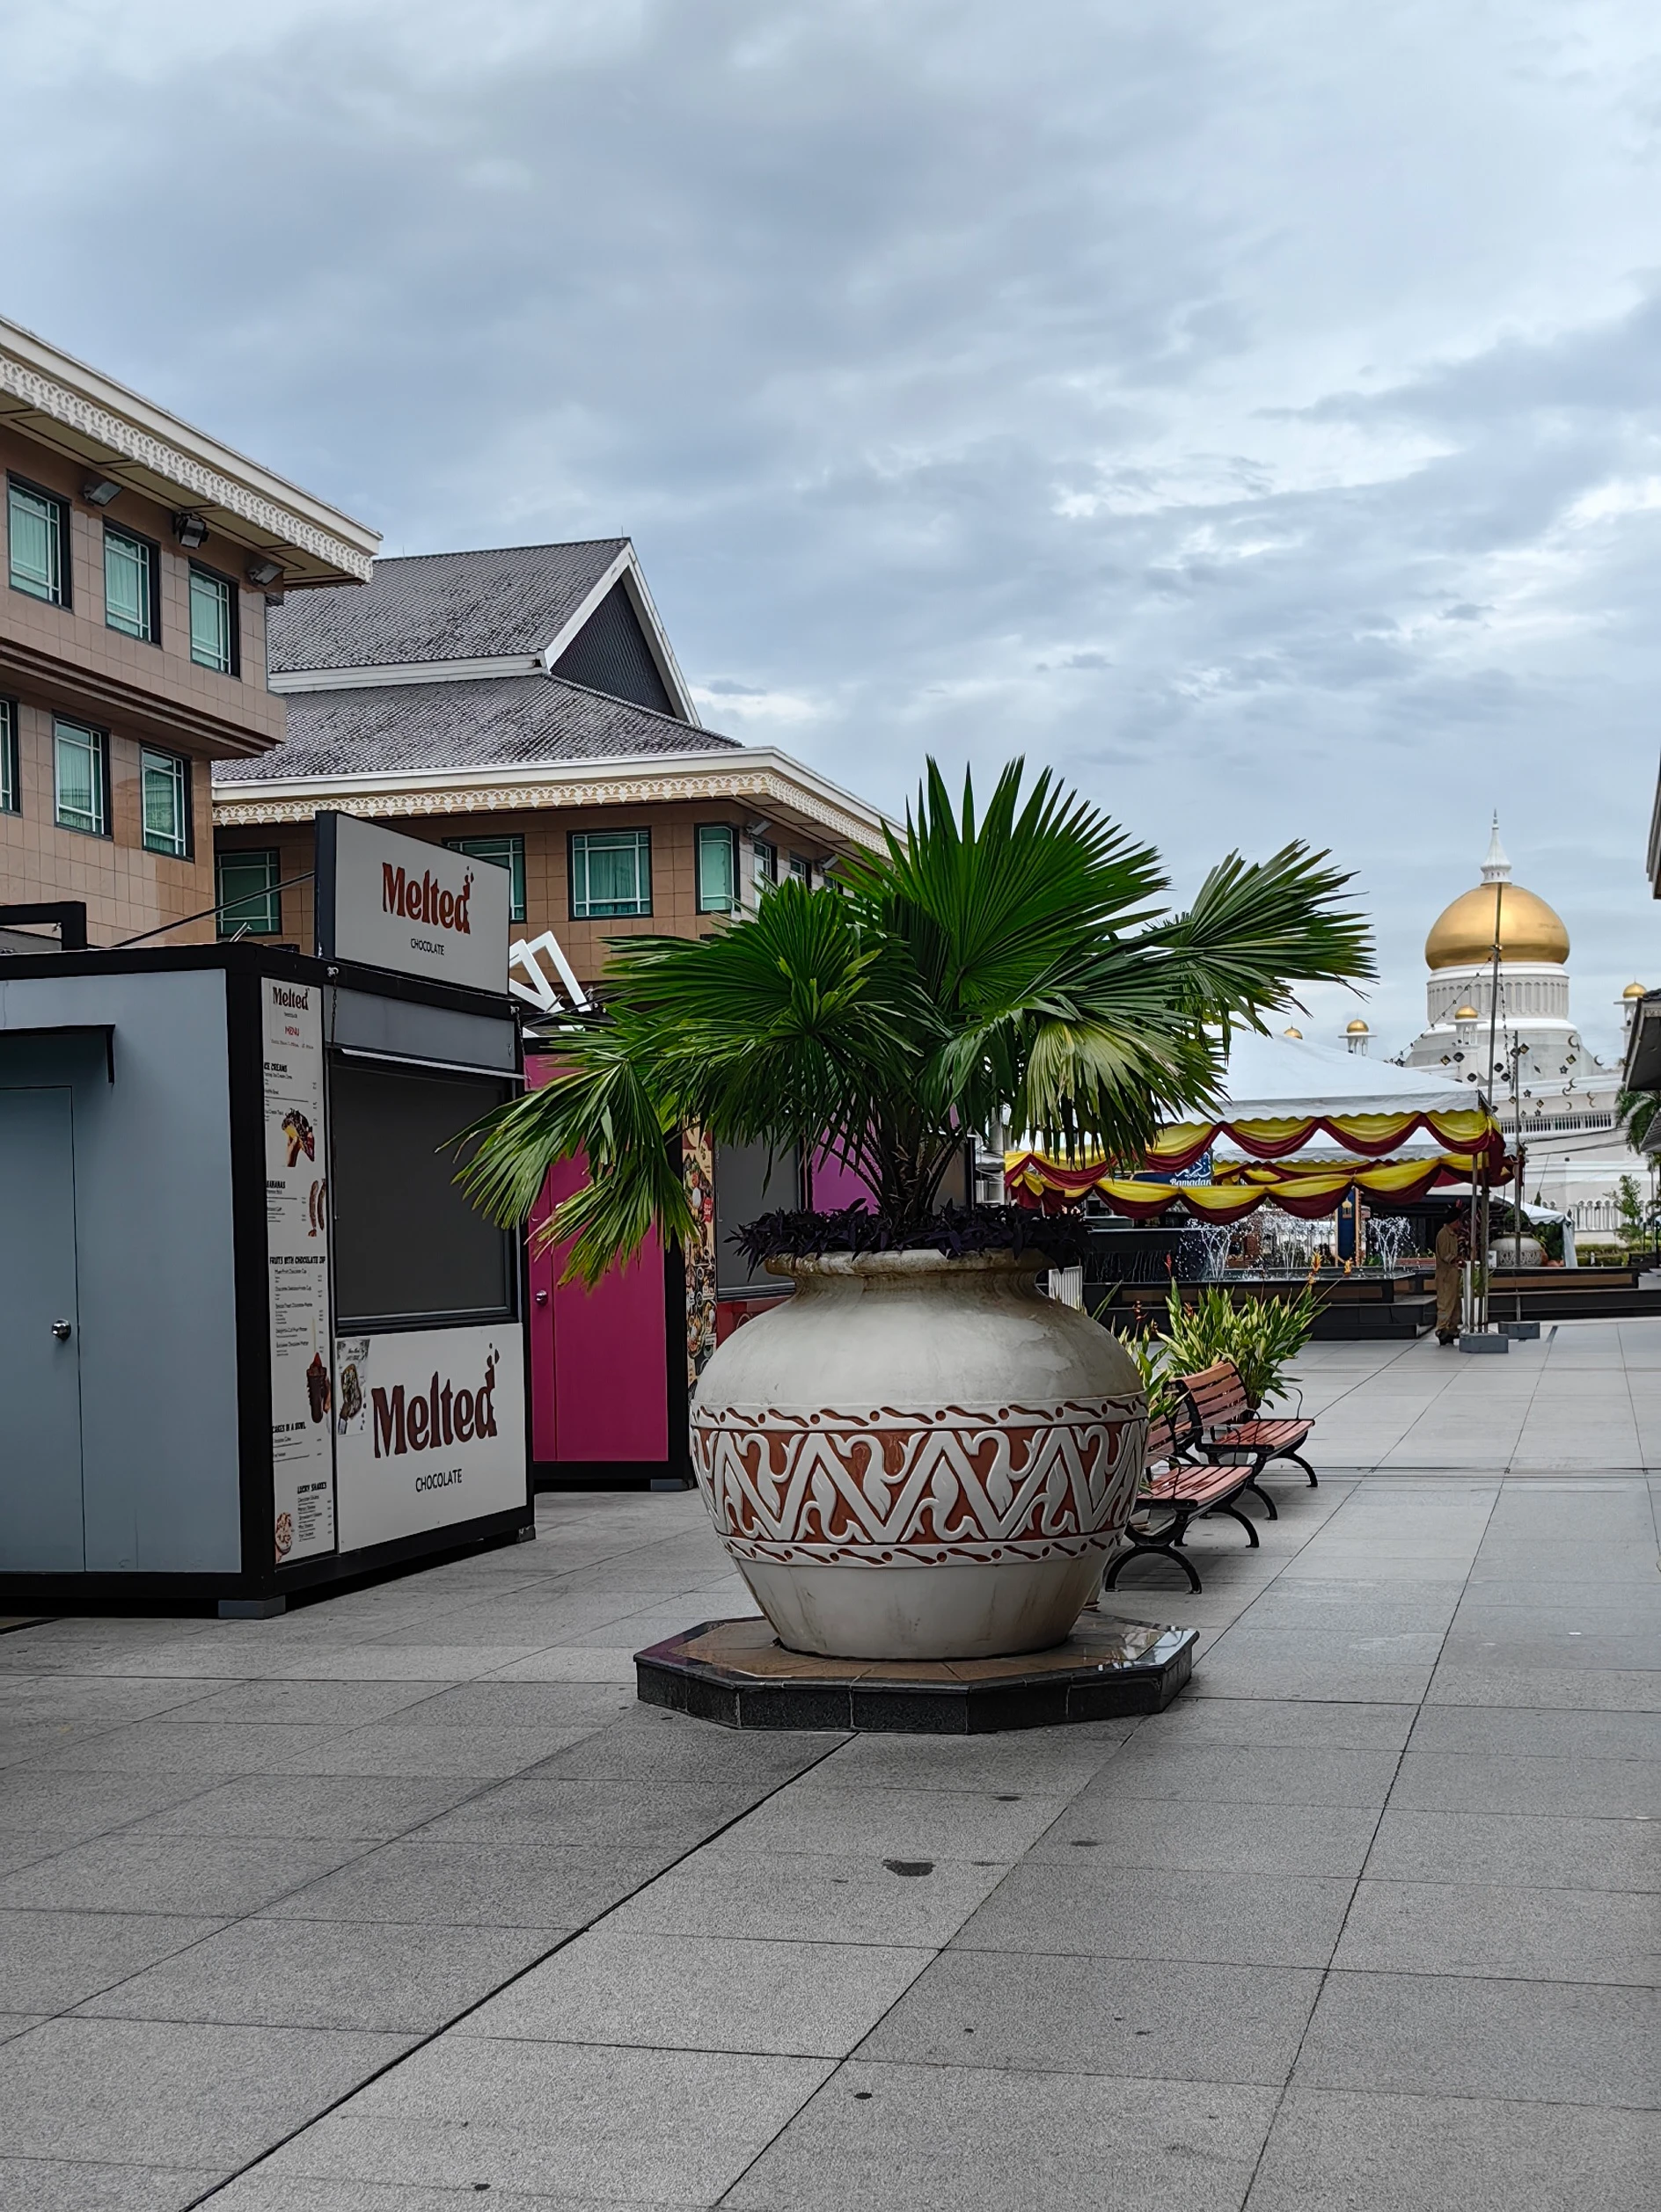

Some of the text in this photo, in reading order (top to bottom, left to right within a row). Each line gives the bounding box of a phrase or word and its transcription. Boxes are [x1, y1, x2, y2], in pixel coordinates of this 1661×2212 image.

[382, 862, 474, 935] Melted
[410, 938, 445, 955] CHOCOLATE
[272, 987, 310, 1011] Melted
[1169, 1178, 1211, 1186] Ramadan
[371, 1343, 500, 1459] Melted
[415, 1468, 463, 1493] CHOCOLATE
